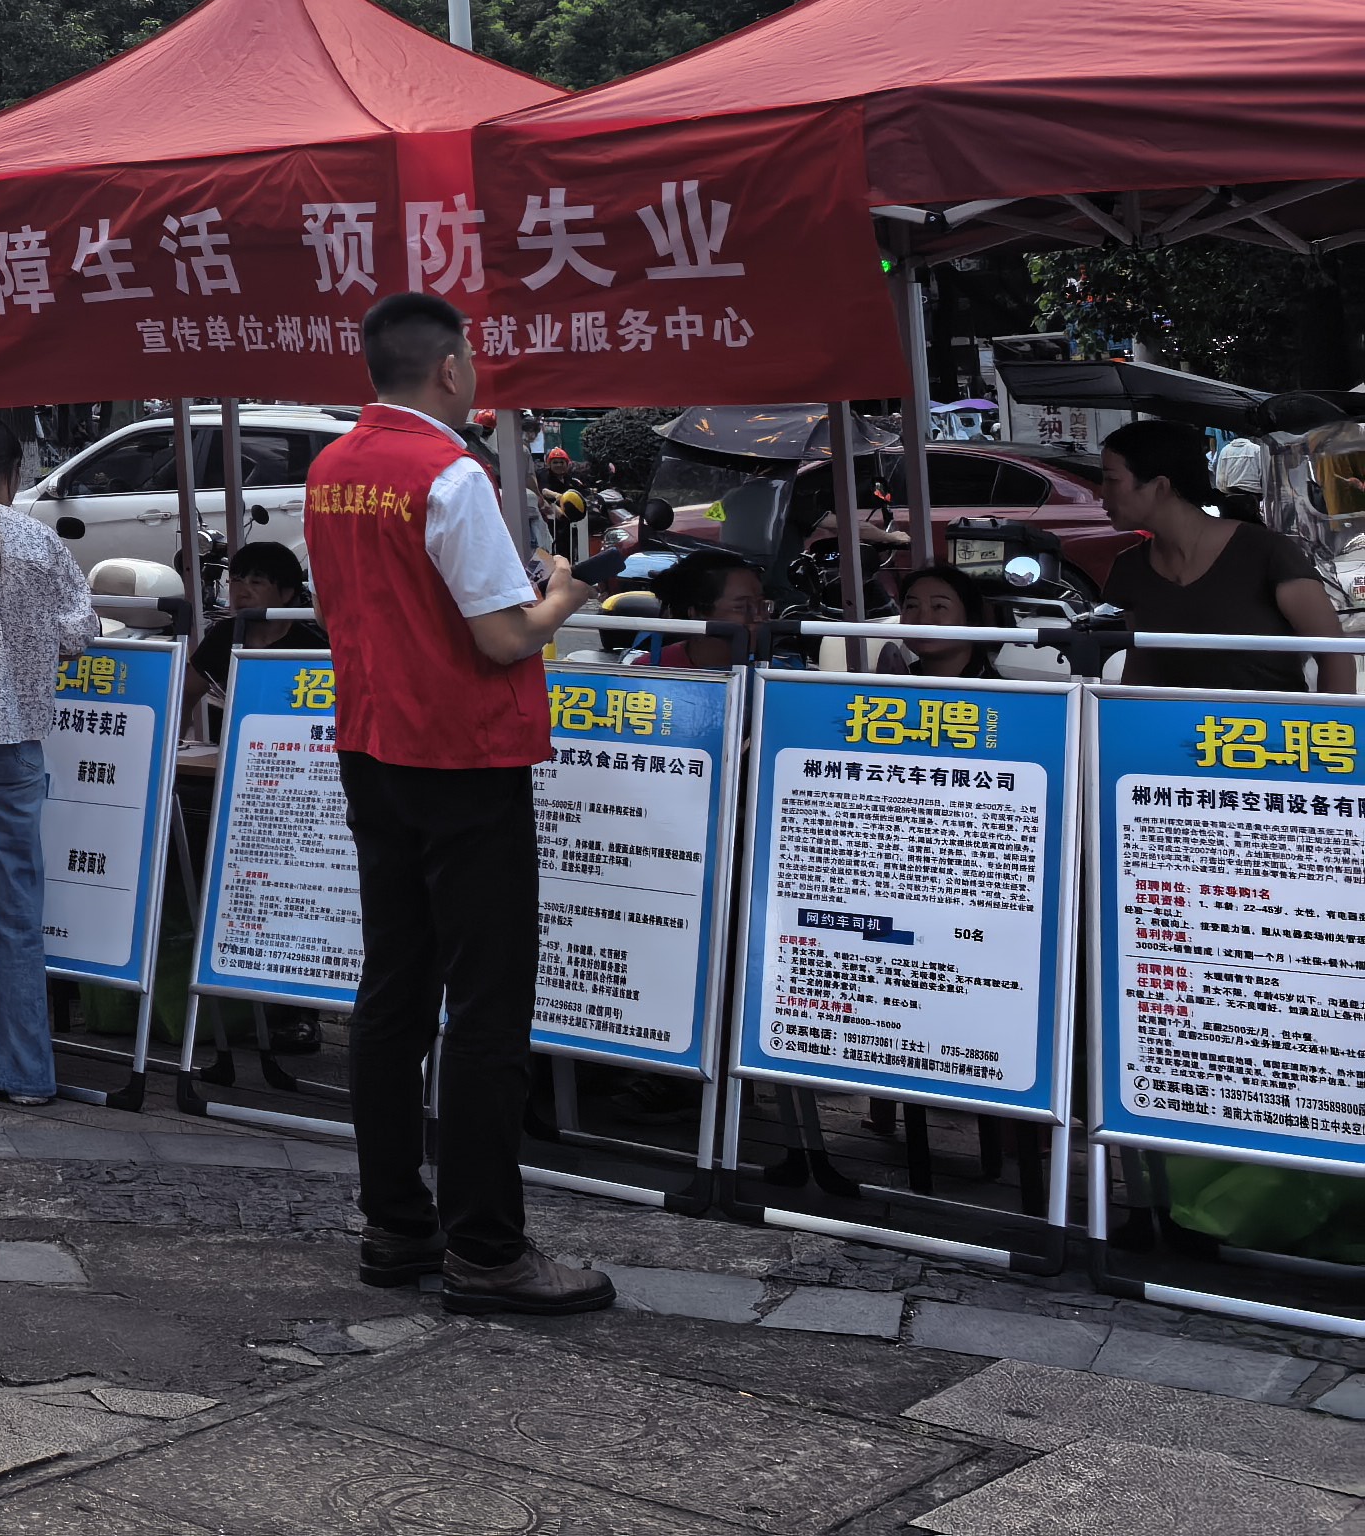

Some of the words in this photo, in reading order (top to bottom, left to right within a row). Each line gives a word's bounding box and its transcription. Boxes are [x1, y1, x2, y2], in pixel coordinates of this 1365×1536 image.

[302, 179, 746, 296] 预防失业
[135, 305, 754, 356] 宣传单位:郴州市就业服务中心
[291, 668, 336, 709] 招
[547, 684, 658, 736] 招聘
[845, 694, 980, 749] 招聘
[985, 707, 999, 733] JOIN
[310, 724, 337, 741] 馒堂
[985, 735, 997, 749] US
[1196, 715, 1357, 773] 招聘
[78, 760, 116, 785] 薪资面议
[803, 758, 1016, 792] 郴州青云汽车有限公司
[68, 848, 107, 875] 薪资面议
[806, 912, 881, 931] 网约车司机
[954, 927, 984, 943] 50名
[1152, 1078, 1216, 1098] 联系电话：
[1152, 1097, 1217, 1115] 公司地址：
[1222, 1105, 1365, 1136] 湘南大市场20栋3楼日立中央空
